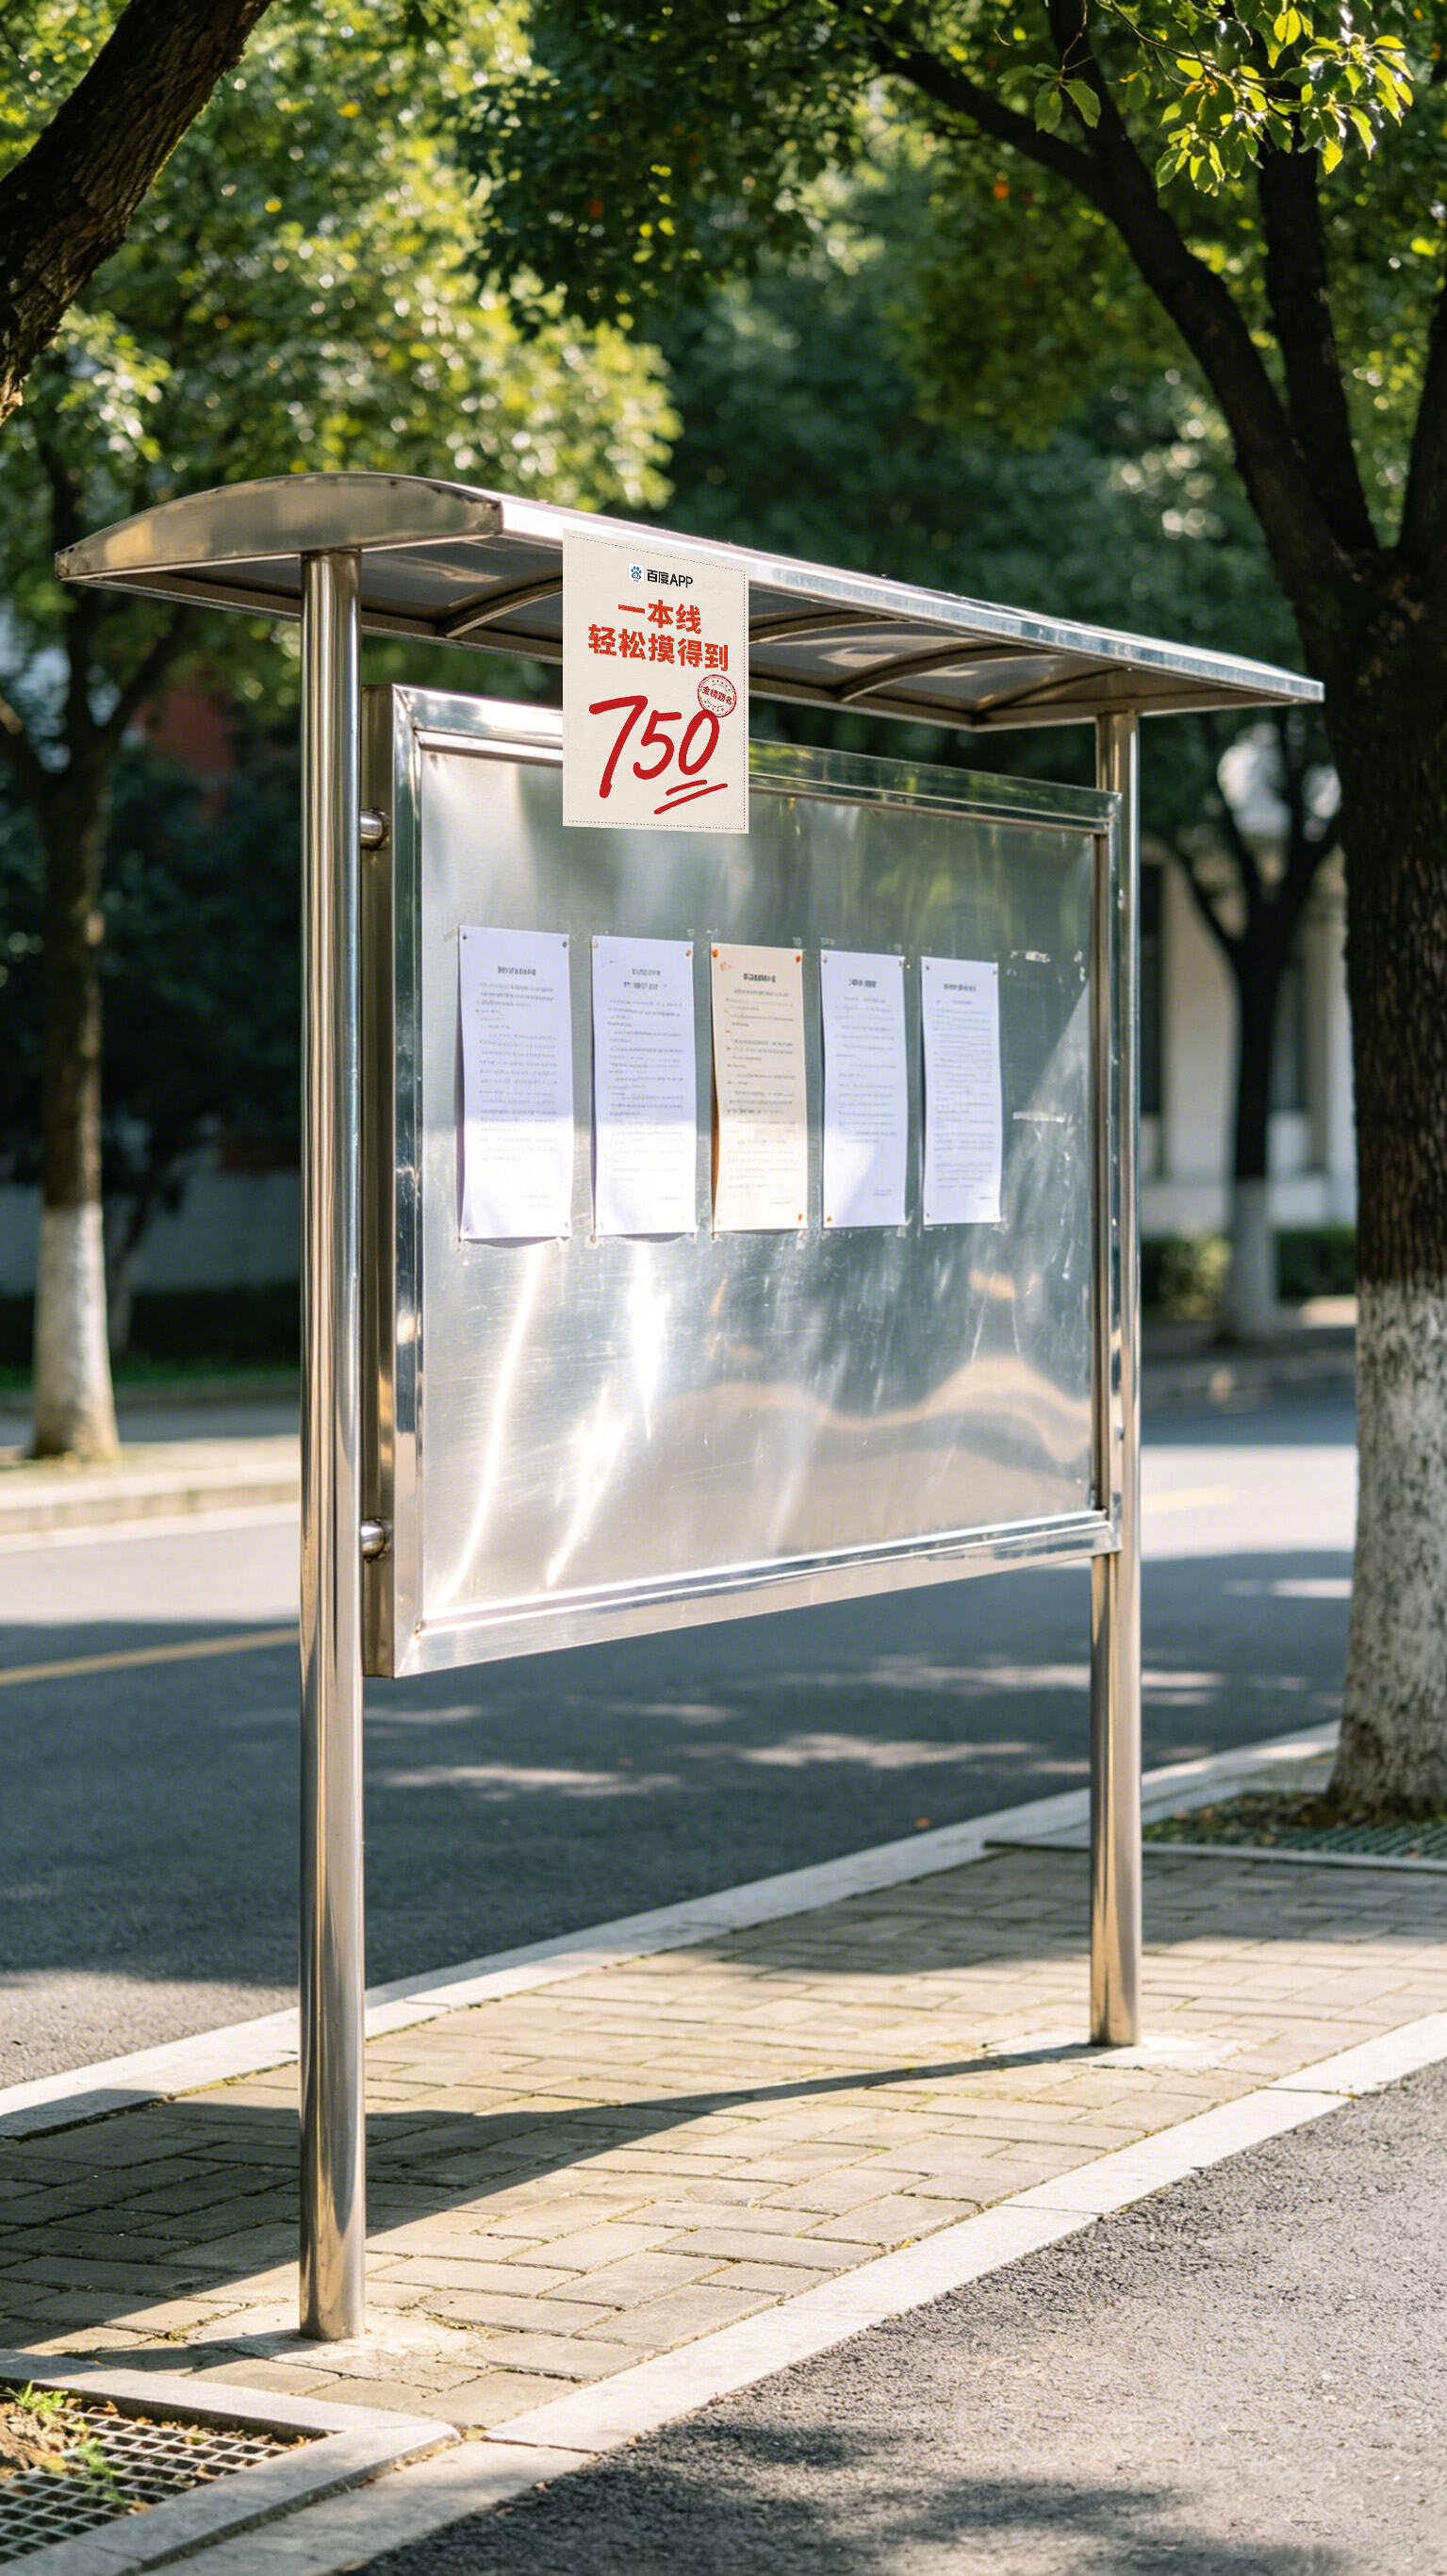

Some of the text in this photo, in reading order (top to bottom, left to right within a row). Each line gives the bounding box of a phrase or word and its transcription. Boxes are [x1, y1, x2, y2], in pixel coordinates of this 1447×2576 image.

[647, 570, 693, 588] 百度APP
[618, 600, 701, 635] 一本线
[588, 624, 729, 671] 轻松摸得到
[589, 695, 720, 799] 750
